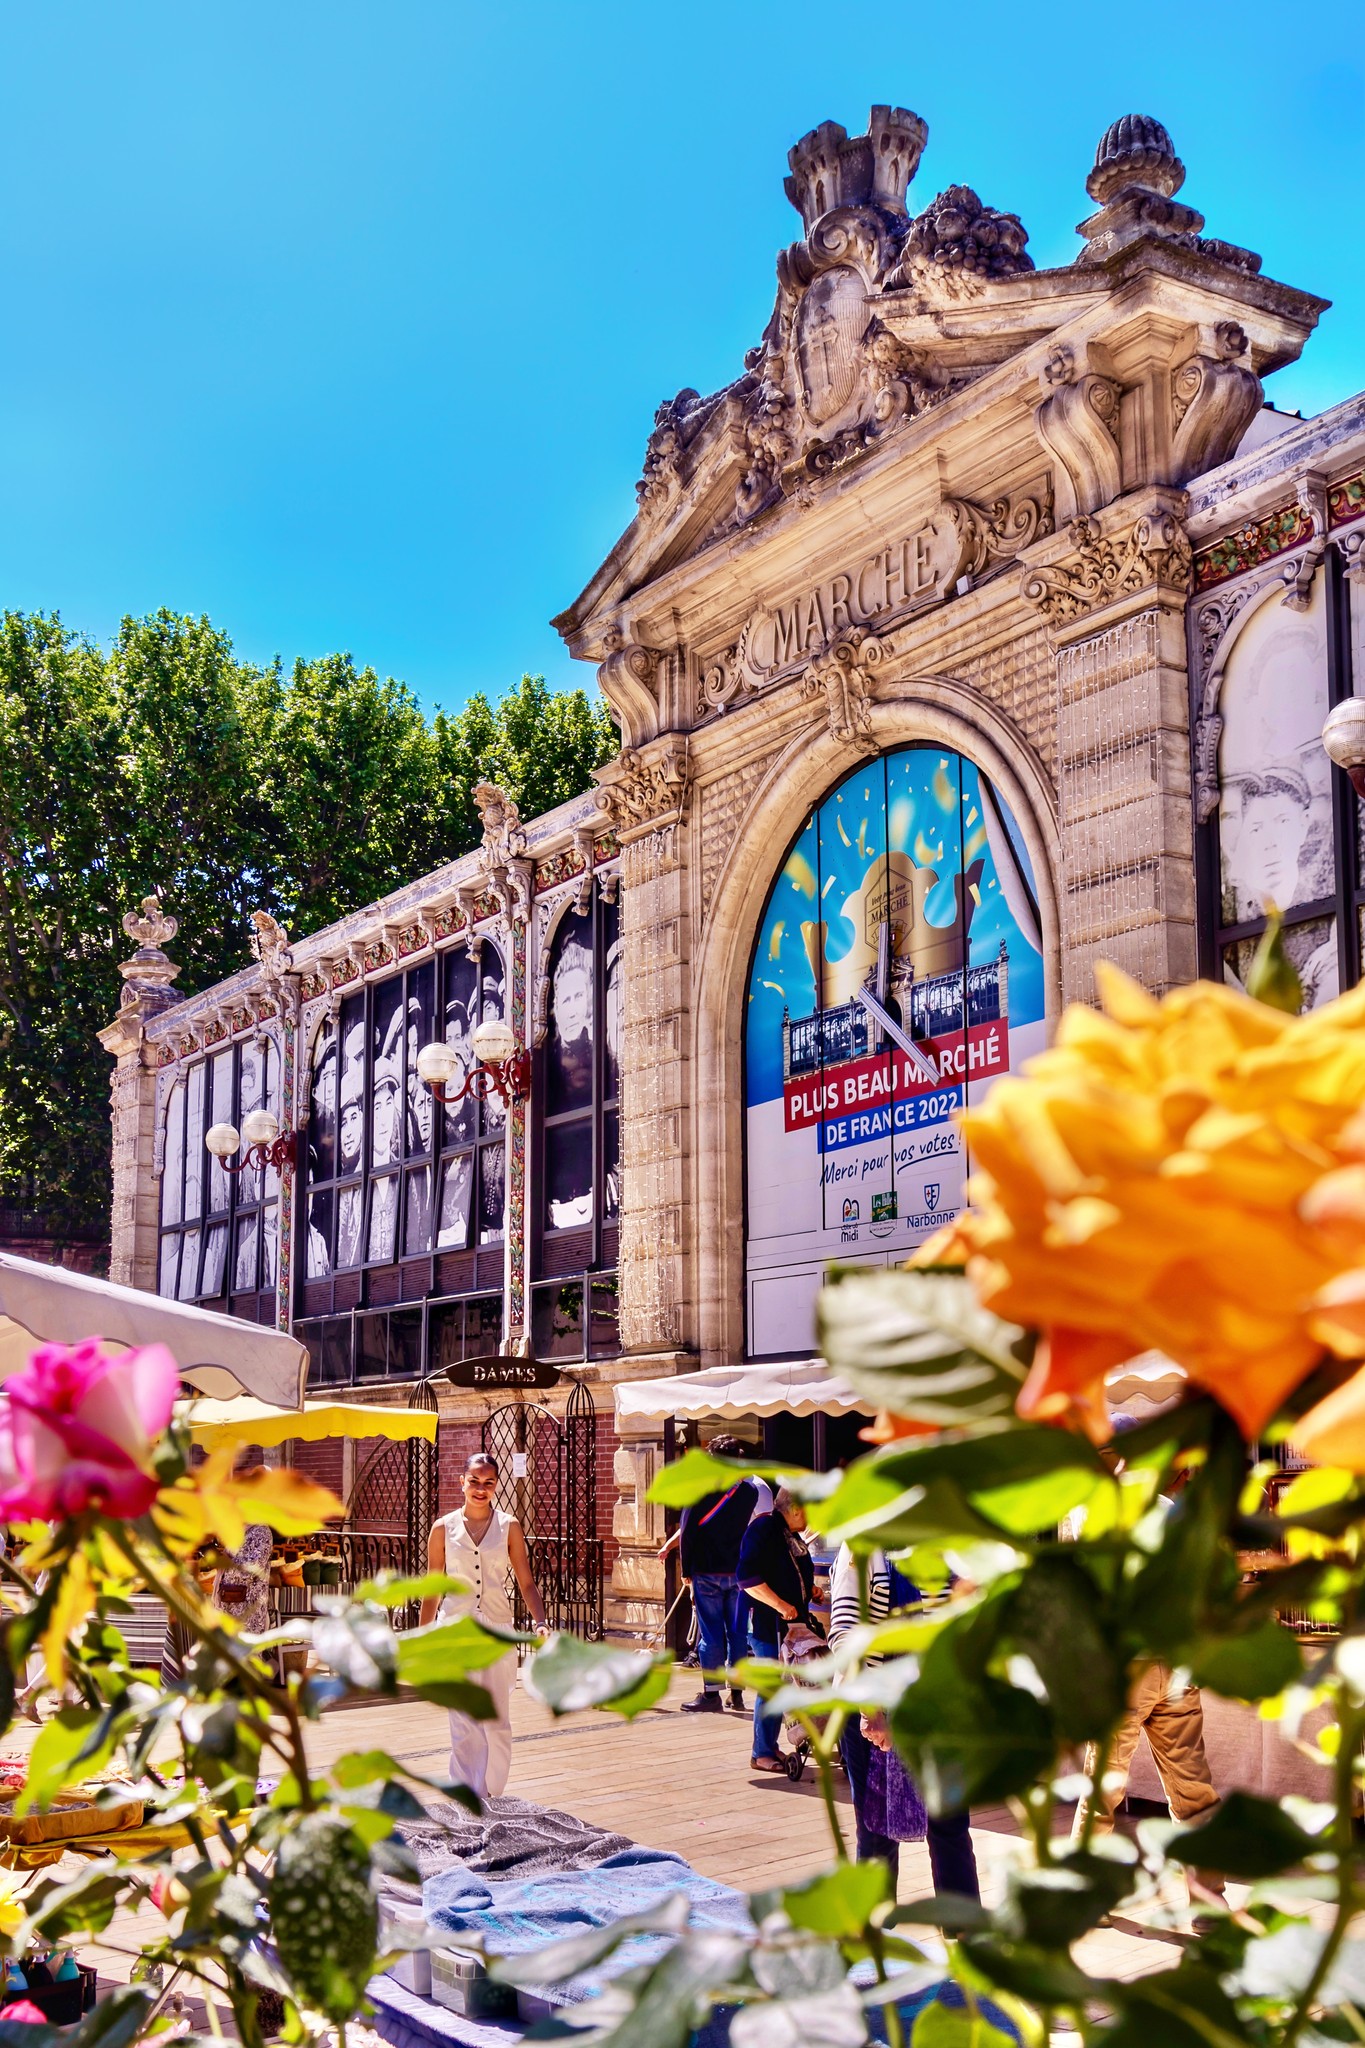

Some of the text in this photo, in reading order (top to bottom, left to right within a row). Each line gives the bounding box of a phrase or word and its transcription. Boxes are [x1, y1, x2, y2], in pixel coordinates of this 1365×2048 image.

[771, 525, 940, 675] MARCHE
[791, 1027, 1001, 1121] PLUS BEAU MARCHÉ
[826, 1091, 960, 1146] DE FRANCE 2022
[819, 1159, 859, 1187] Merci
[861, 1154, 889, 1181] pour
[893, 1144, 914, 1163] vos
[919, 1132, 955, 1155] votes
[906, 1211, 955, 1229] Narbonne
[473, 1365, 537, 1382] DAMES
